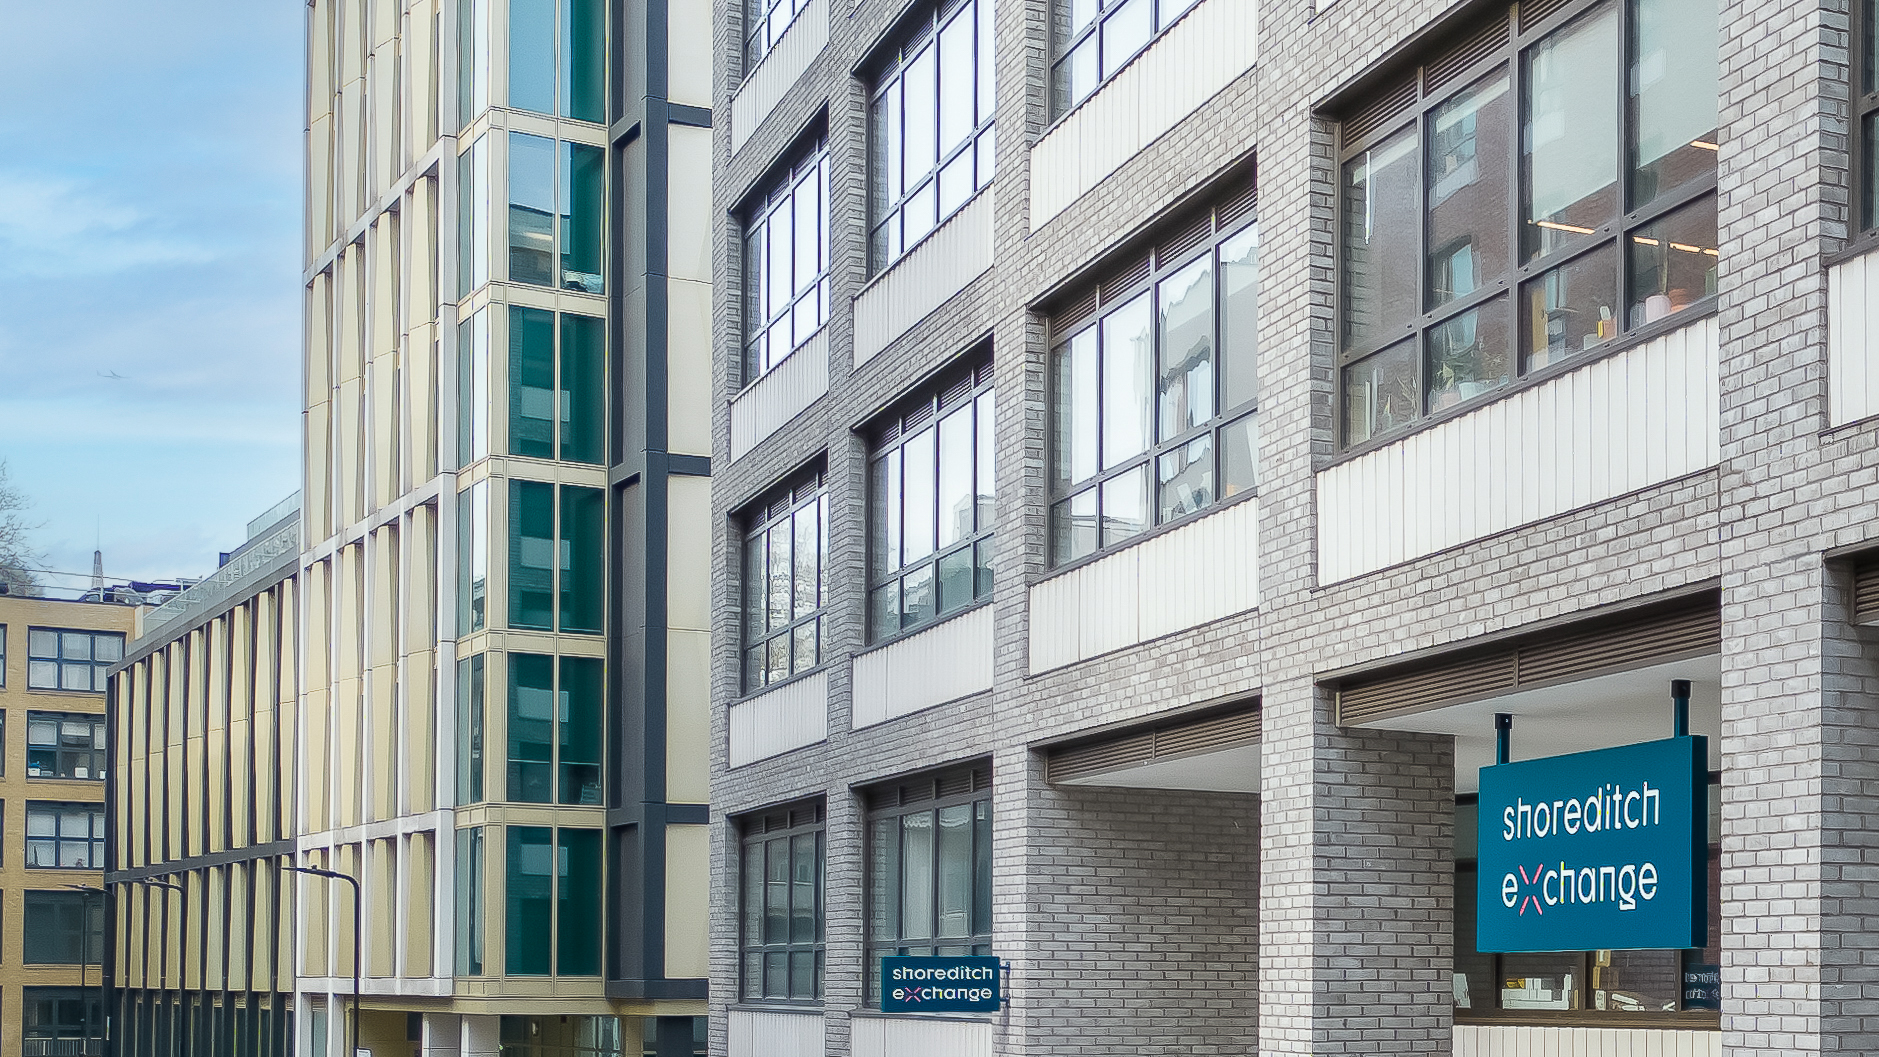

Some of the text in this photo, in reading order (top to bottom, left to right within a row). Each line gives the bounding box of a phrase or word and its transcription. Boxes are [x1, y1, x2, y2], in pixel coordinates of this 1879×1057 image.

[1503, 780, 1660, 841] shoreditch
[1501, 860, 1659, 917] exchange
[892, 965, 993, 980] shoreditch
[892, 986, 993, 1003] exchange
